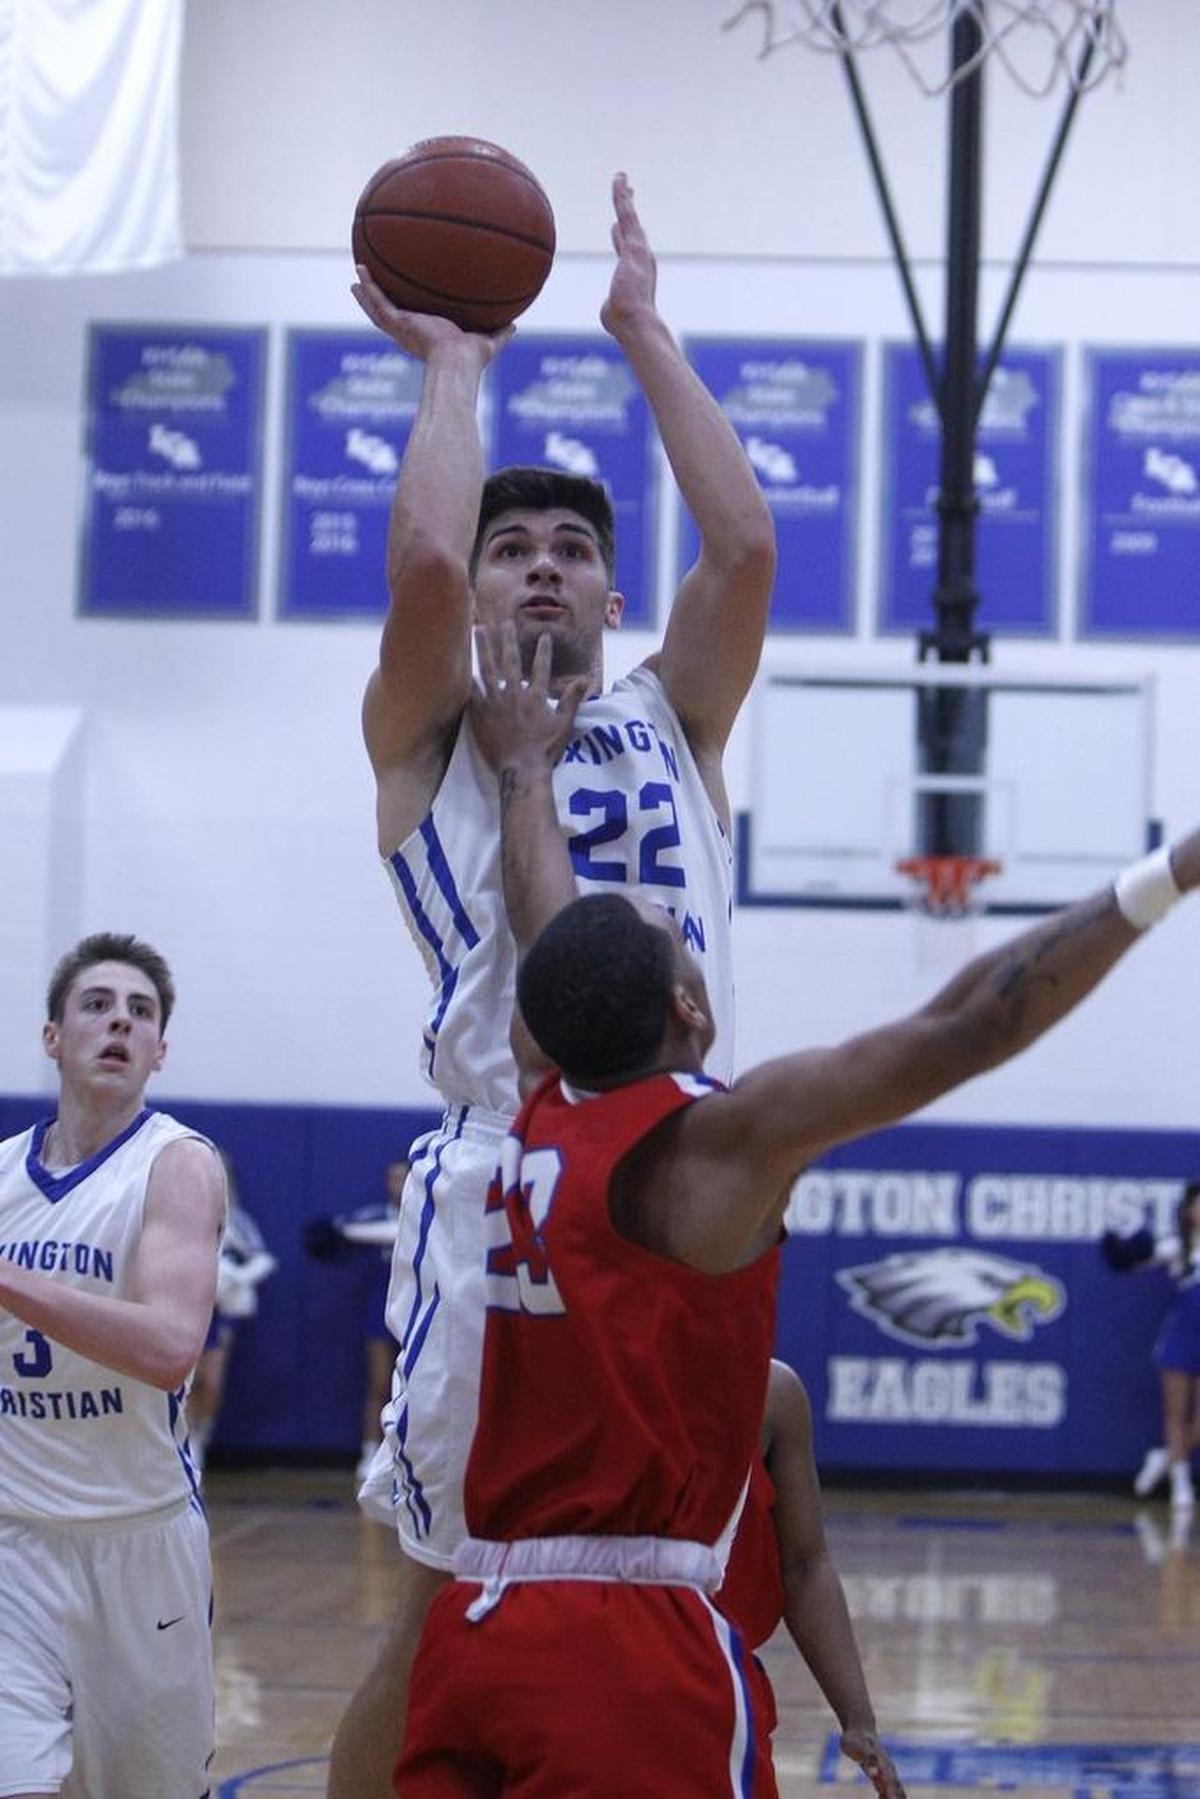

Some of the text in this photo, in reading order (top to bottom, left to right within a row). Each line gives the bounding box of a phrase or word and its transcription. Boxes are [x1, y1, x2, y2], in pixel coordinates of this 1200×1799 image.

[568, 781, 686, 888] 22
[785, 1169, 957, 1238] GTON
[0, 1387, 123, 1420] RISTIAN
[827, 1355, 1068, 1428] EAGLES
